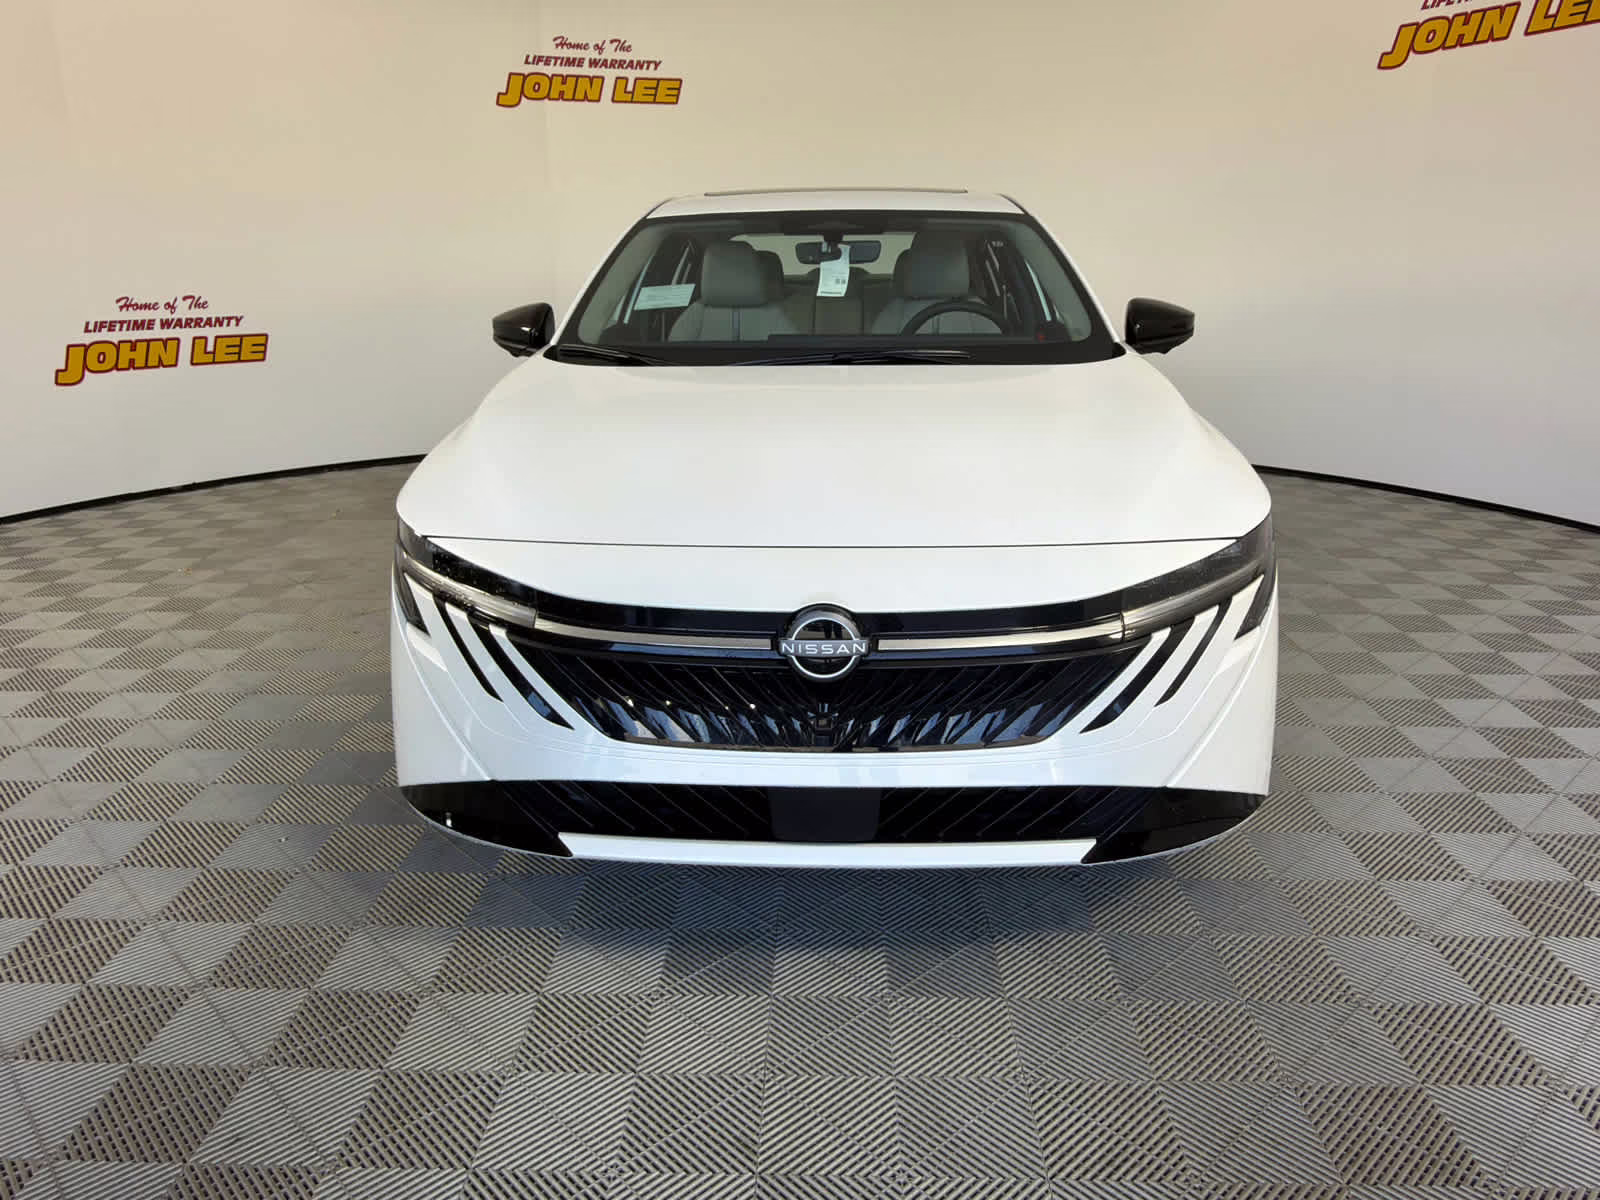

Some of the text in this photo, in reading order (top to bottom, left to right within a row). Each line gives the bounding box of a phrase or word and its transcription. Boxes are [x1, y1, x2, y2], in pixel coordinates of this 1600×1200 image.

[552, 35, 632, 55] Home of The
[1377, 1, 1521, 70] JOHN
[523, 54, 662, 71] LIFETIME WARRANTY
[496, 71, 683, 108] JOHN LEE
[115, 295, 209, 315] Home of The
[83, 315, 244, 334] LIFETIME WARRANTY
[54, 333, 269, 387] JOHN LEE
[781, 642, 866, 655] NISSAN
